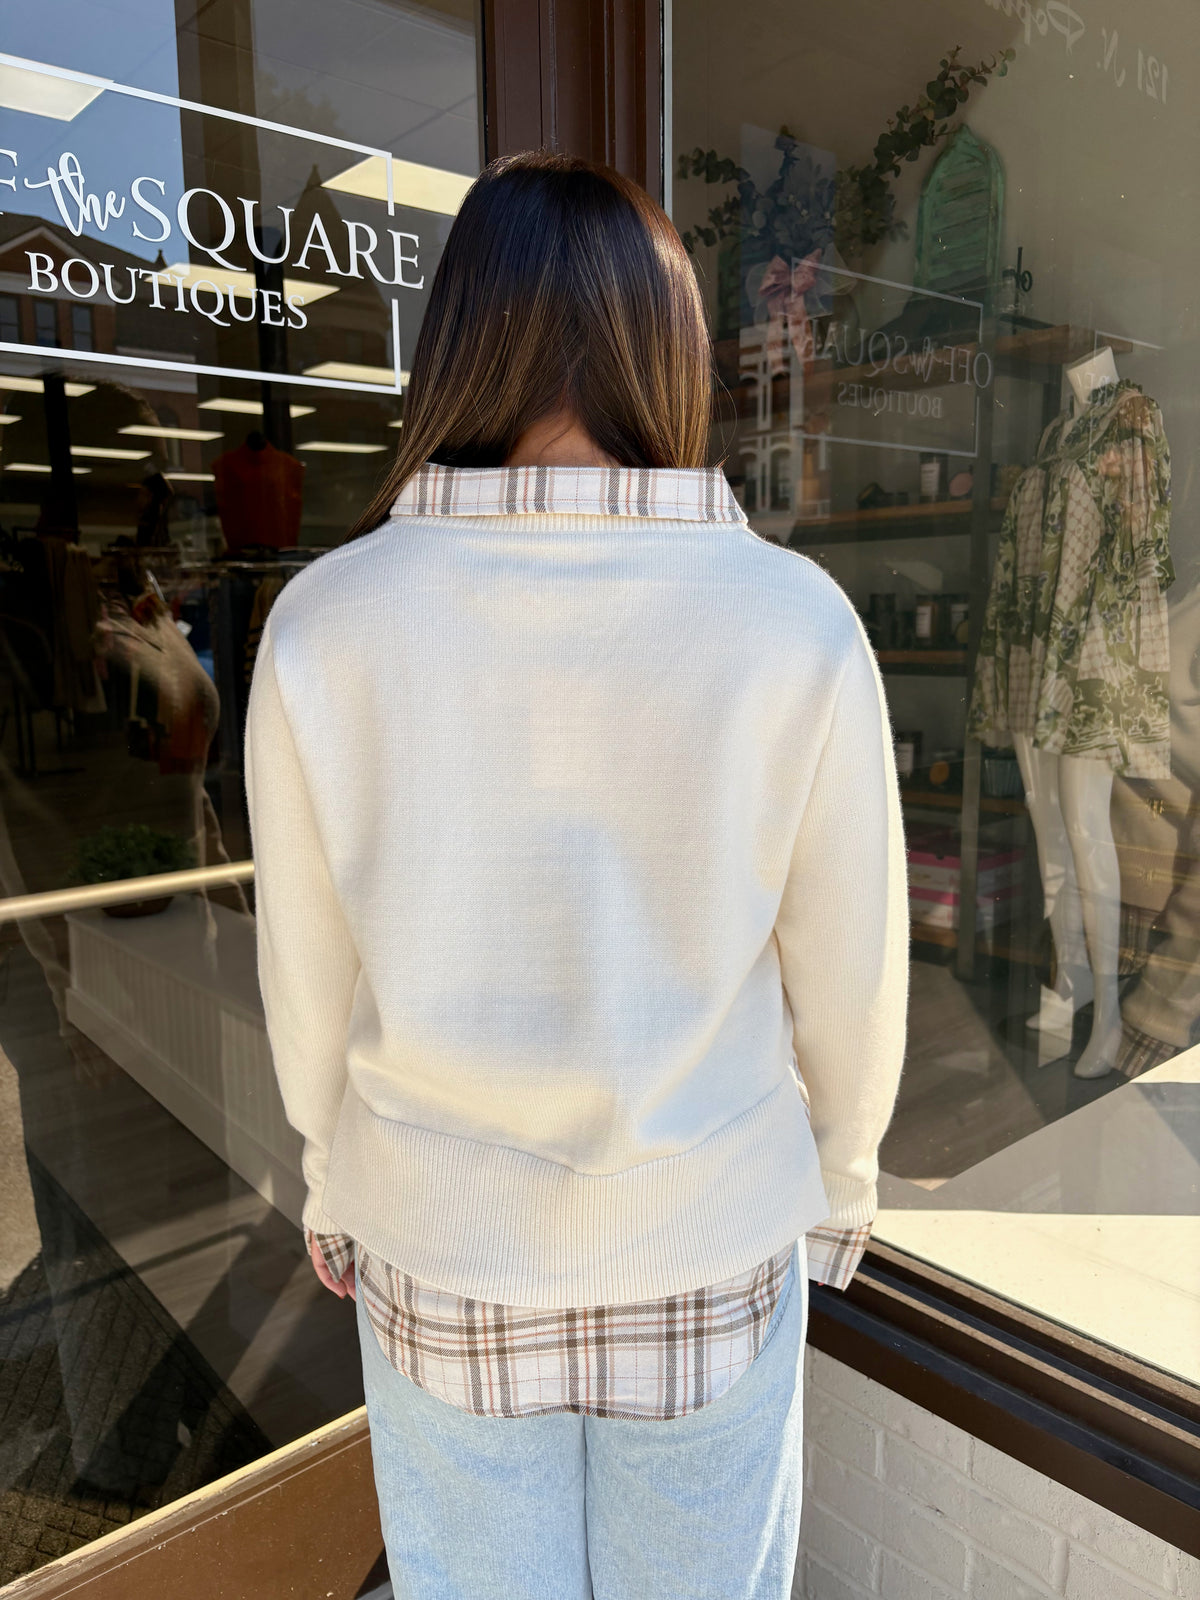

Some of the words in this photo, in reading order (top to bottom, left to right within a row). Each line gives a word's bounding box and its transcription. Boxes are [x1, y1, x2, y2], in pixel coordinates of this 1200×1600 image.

[24, 151, 126, 237] the
[130, 176, 425, 290] SQUARE
[24, 250, 308, 331] BOUTIQUES
